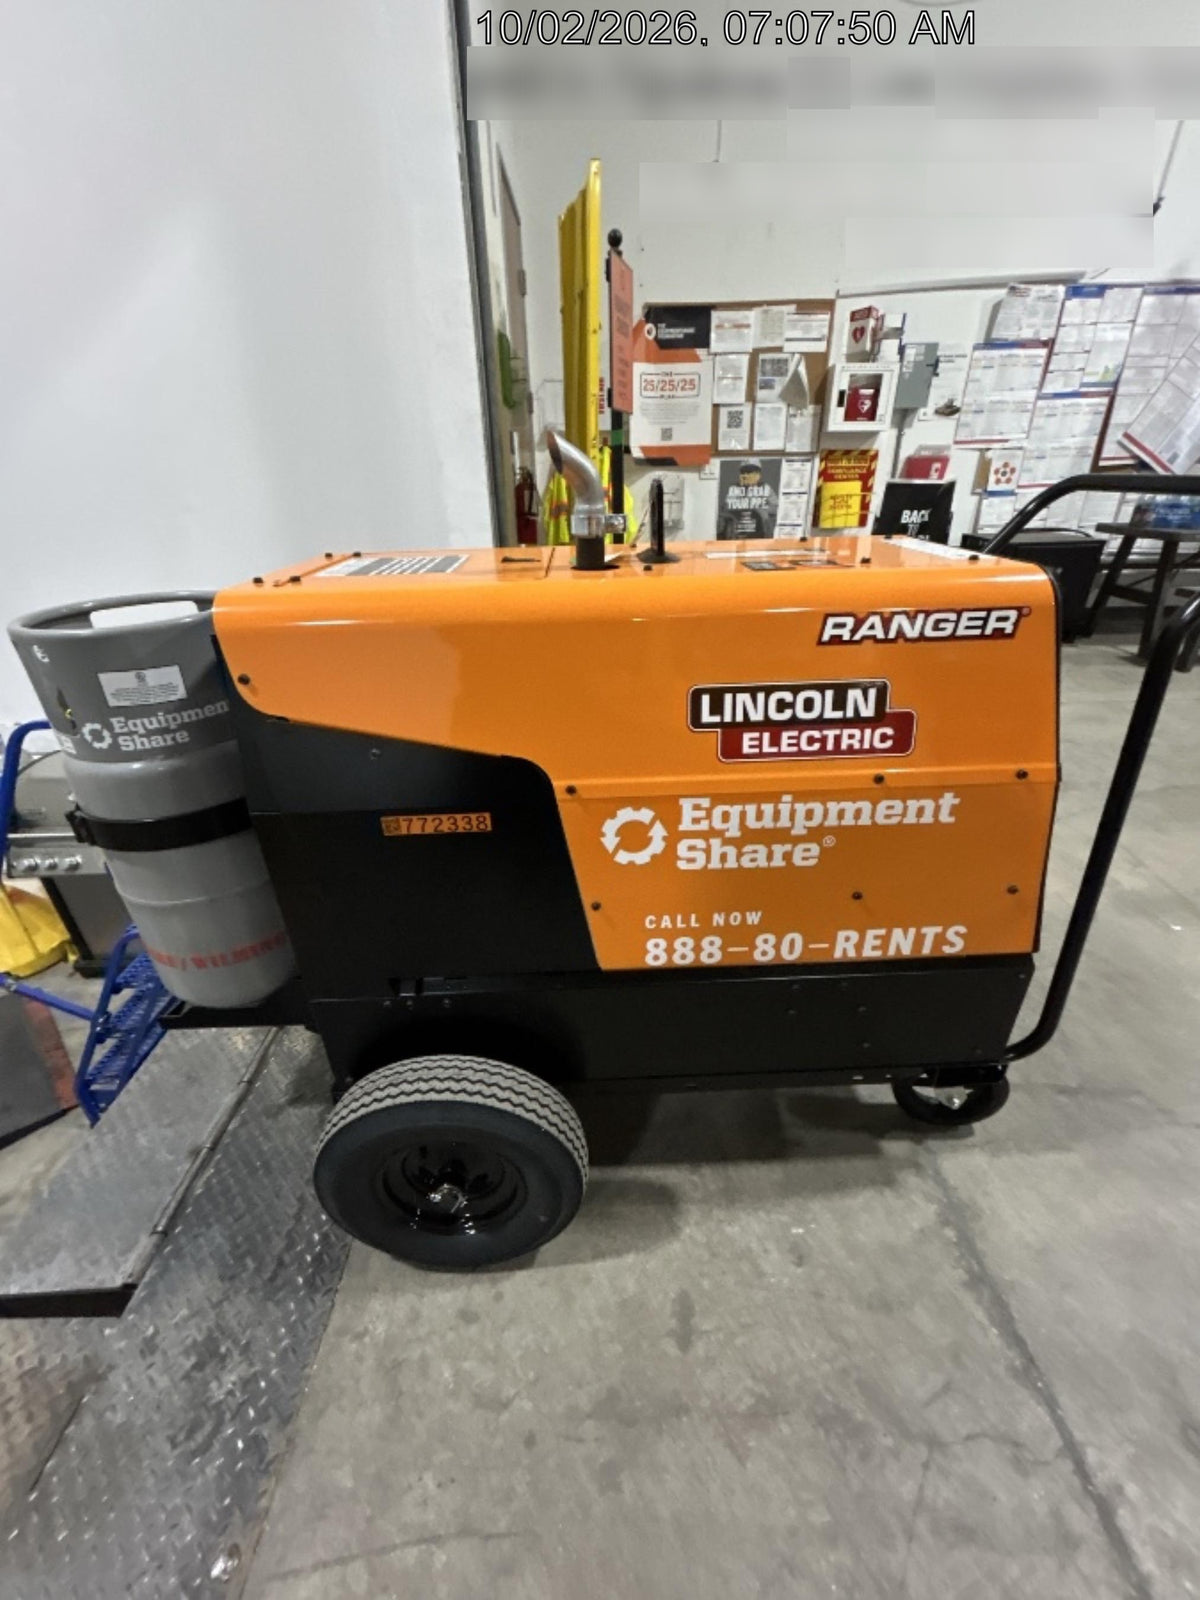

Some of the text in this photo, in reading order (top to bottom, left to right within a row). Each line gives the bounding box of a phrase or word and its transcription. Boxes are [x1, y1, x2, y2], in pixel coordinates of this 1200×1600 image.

[643, 378, 696, 392] 25/25/25
[728, 485, 746, 497] AND
[727, 497, 749, 510] YOUR
[110, 698, 230, 734] Equipmen
[701, 688, 879, 724] LINCOLN
[117, 729, 190, 752] Share
[741, 726, 895, 755] ELECTRIC
[402, 814, 488, 834] 772338
[678, 791, 960, 838] Equipment
[645, 911, 763, 930] CALL NOW
